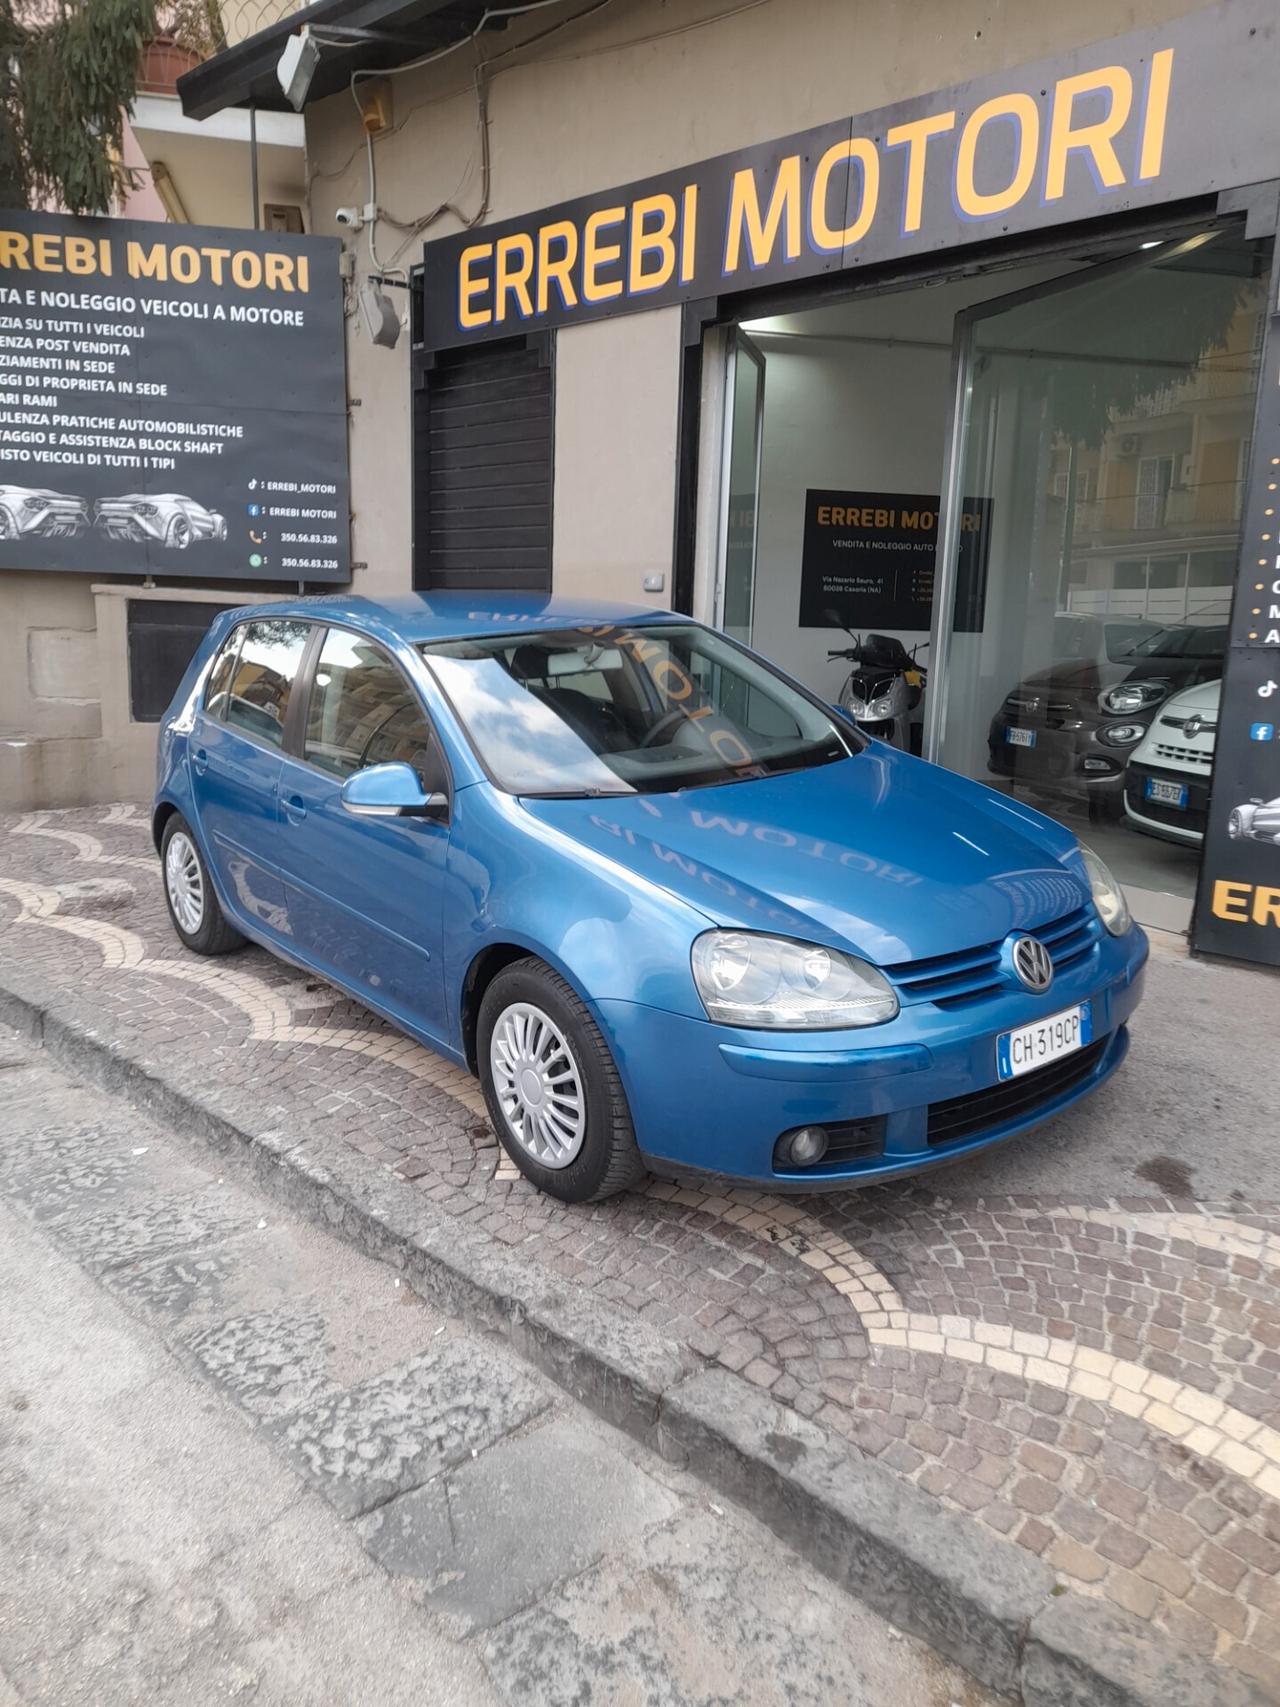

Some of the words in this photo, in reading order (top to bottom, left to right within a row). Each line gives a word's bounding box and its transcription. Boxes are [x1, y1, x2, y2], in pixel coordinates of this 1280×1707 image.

[457, 183, 698, 330] ERREBI
[722, 48, 1174, 274] MOTORI
[126, 241, 309, 293] MOTORI
[26, 290, 36, 306] E
[40, 290, 136, 312] NOLEGGIO
[140, 298, 208, 319] VEICOLI
[213, 304, 226, 320] A
[230, 306, 304, 326] MOTORE
[0, 316, 23, 329] ZIA
[25, 318, 43, 330] SU
[46, 320, 83, 334] TUTTI
[87, 322, 91, 334] I
[94, 323, 144, 338] VEICOLI
[36, 338, 70, 352] POST
[72, 341, 130, 356] VENDITA
[65, 358, 80, 371] IN
[84, 360, 116, 374] SEDE
[25, 375, 39, 388] DI
[43, 376, 115, 392] PROPRIETA
[118, 382, 132, 394] IN
[136, 383, 168, 396] SEDE
[22, 394, 57, 407] RAMI
[52, 414, 116, 430] PRATICHE
[118, 419, 244, 438] AUTOMOBILISTICHE
[49, 433, 56, 444] E
[59, 433, 136, 449] ASSISTENZA
[138, 438, 182, 452] BLOCK
[184, 441, 224, 454] SHAFT
[32, 450, 84, 464] VEICOLI
[87, 454, 101, 465] DI
[104, 454, 140, 467] TUTTI
[144, 456, 148, 468] I
[150, 457, 175, 470] TIPI
[267, 481, 336, 494] ERREBI_MOTORI
[269, 507, 300, 517] ERREBI
[302, 508, 336, 519] MOTORI
[817, 506, 895, 528] ERREBI
[832, 540, 864, 549] VENDITA
[866, 541, 870, 549] E
[872, 541, 912, 550] NOLEGGIO
[913, 543, 934, 552] AUTO
